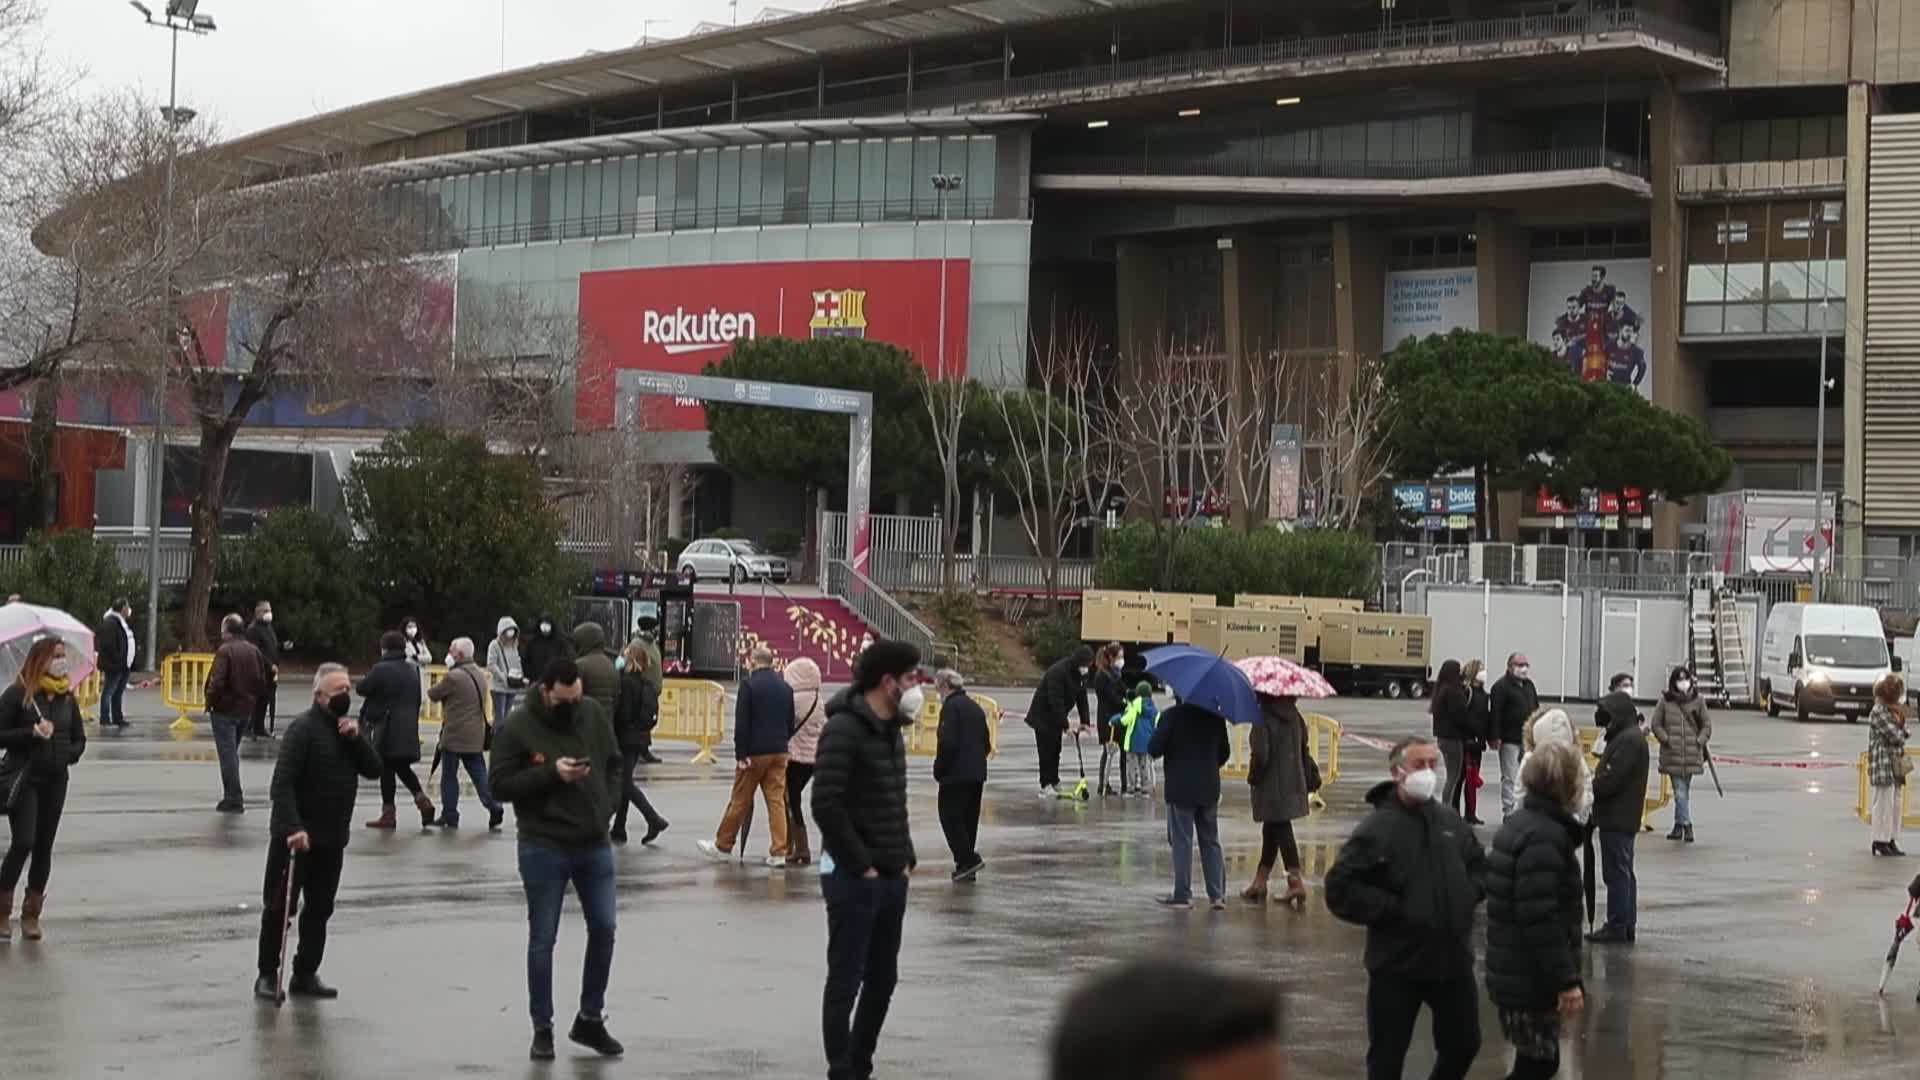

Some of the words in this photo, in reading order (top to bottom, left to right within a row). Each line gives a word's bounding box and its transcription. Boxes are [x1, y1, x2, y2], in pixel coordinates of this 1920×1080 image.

[1393, 277, 1437, 290] Everyone
[1439, 277, 1455, 286] can
[1456, 274, 1472, 285] live
[1401, 287, 1441, 299] healthier
[1444, 287, 1459, 297] life
[1393, 302, 1414, 312] with
[1416, 301, 1439, 311] Beko
[643, 307, 755, 344] Rakuten
